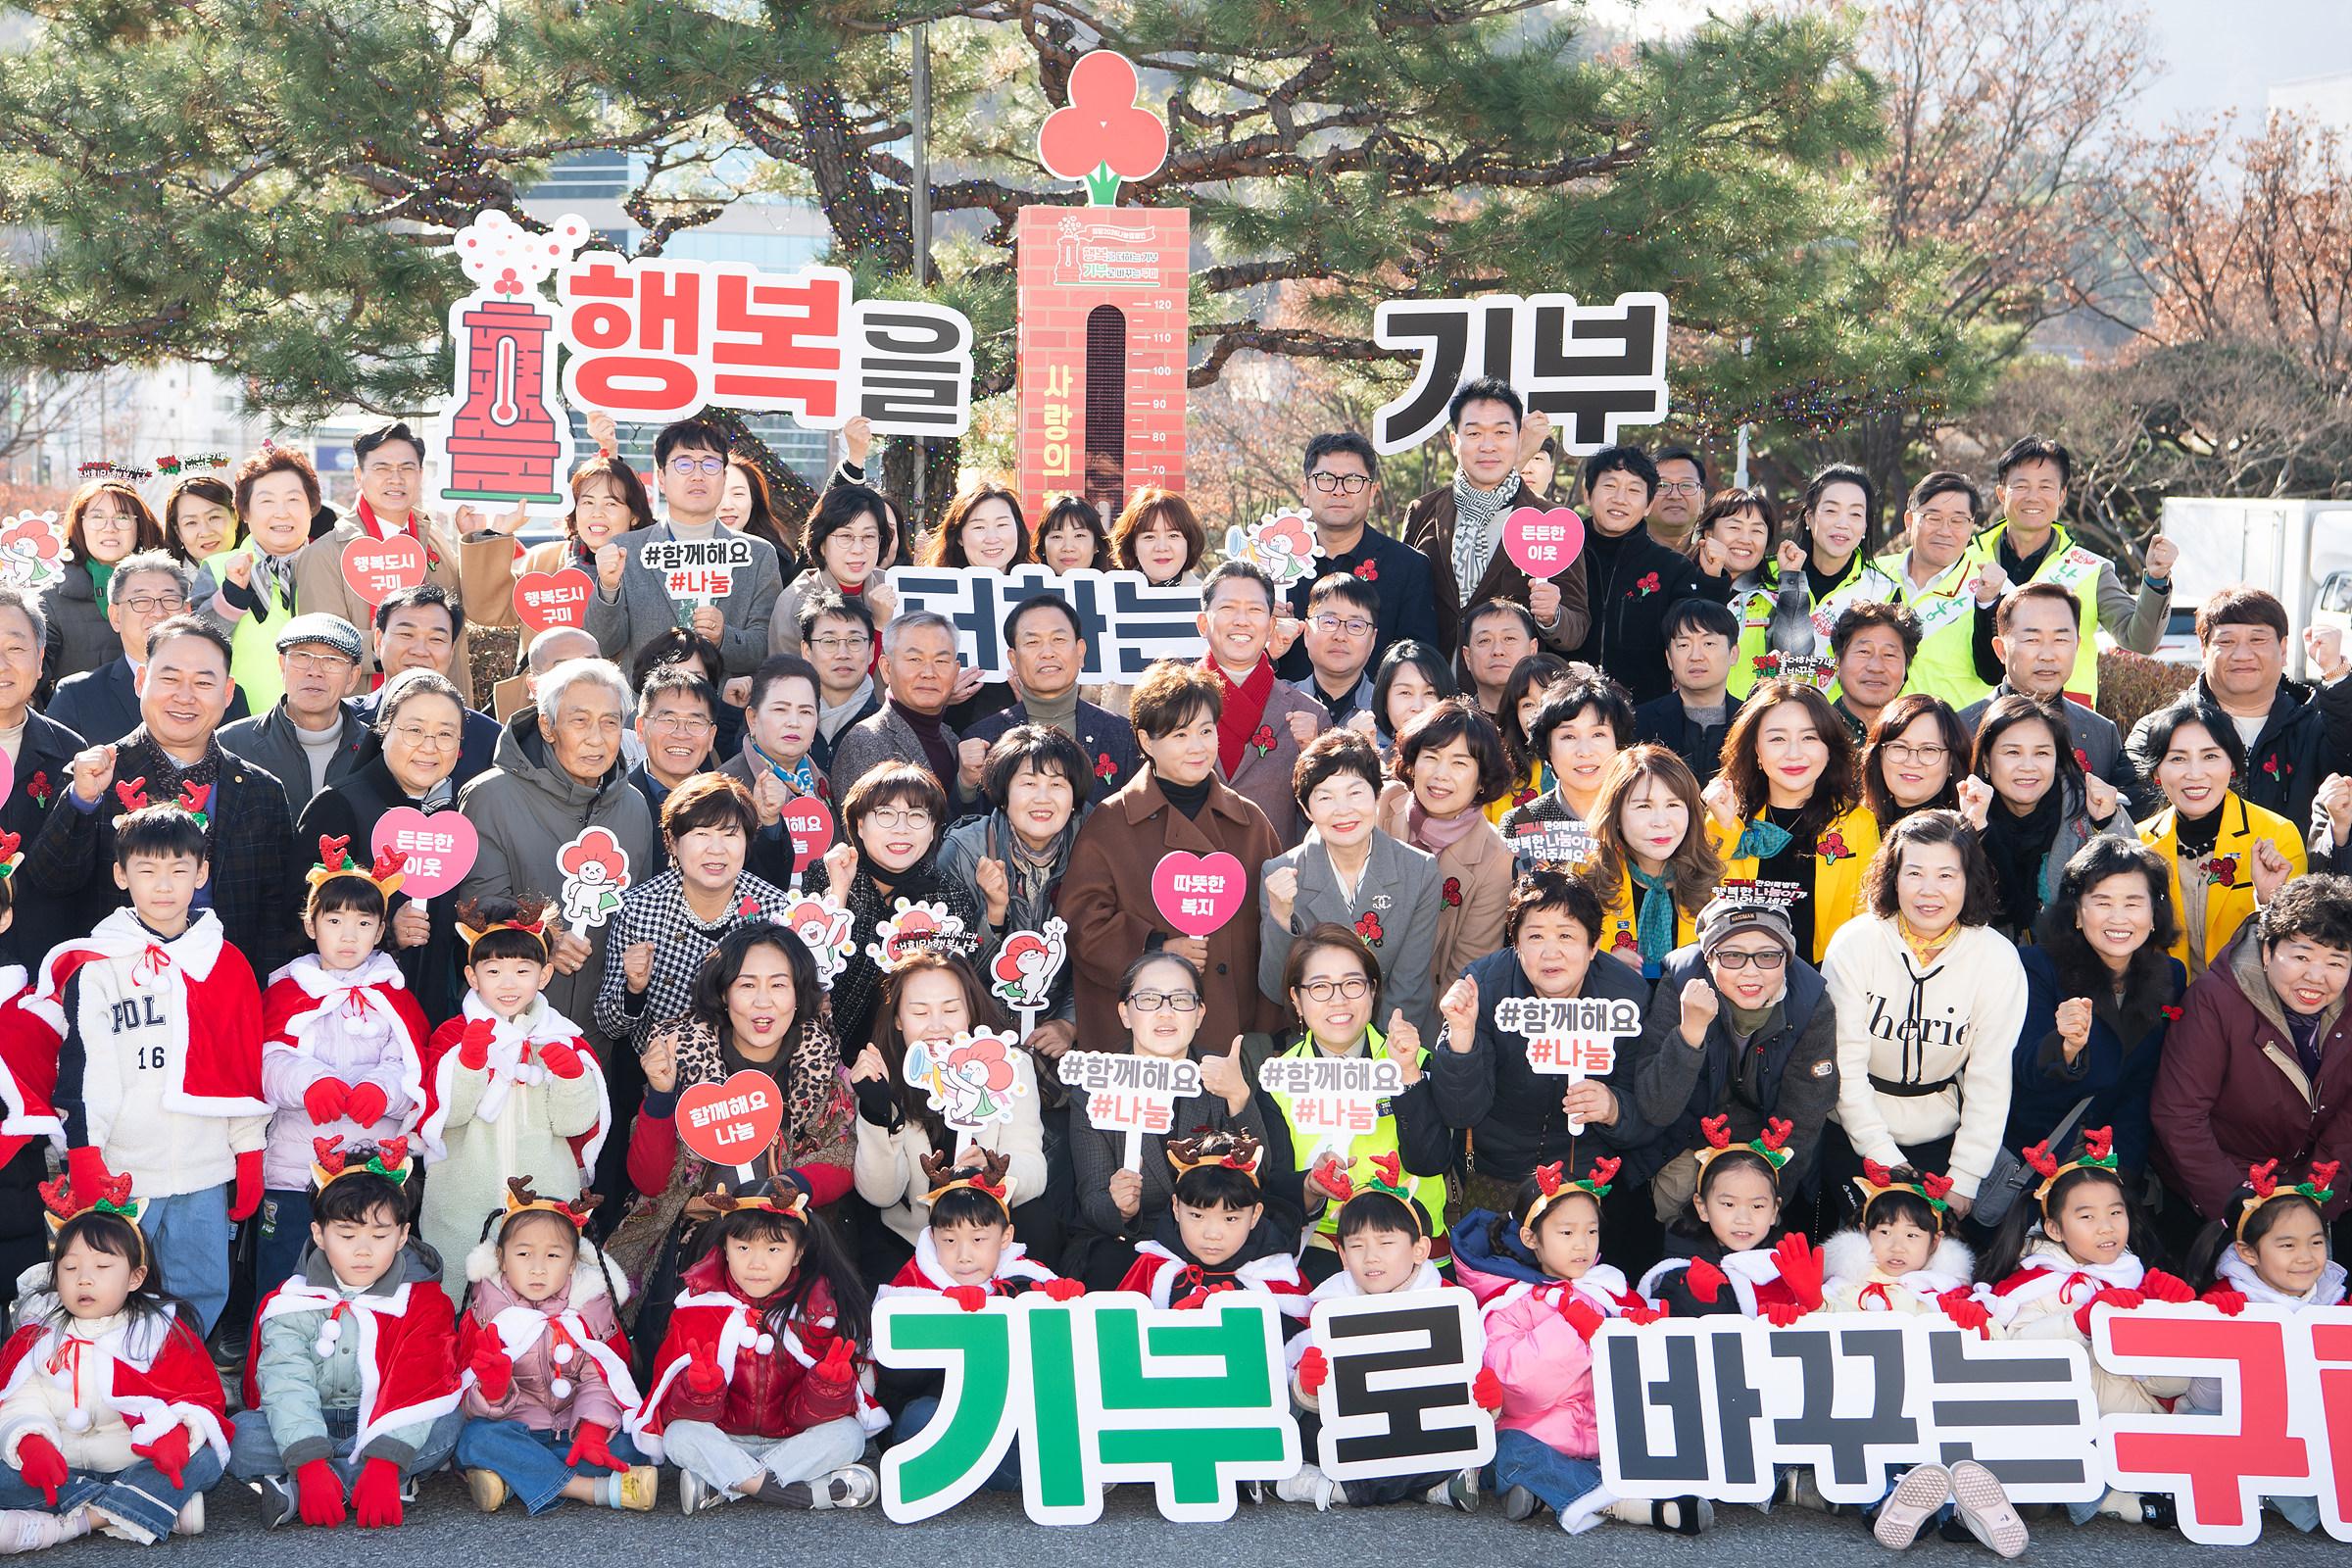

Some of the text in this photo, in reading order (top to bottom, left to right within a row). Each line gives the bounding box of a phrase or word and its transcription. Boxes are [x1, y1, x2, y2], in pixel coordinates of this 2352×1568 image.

[1153, 300, 1172, 310] 120
[1153, 333, 1172, 342] 110
[1152, 367, 1171, 376] 100
[1386, 305, 1656, 444] 기부
[1152, 400, 1167, 409] 90
[1042, 365, 1073, 477] 사랑의
[1152, 432, 1166, 442] 80
[1152, 466, 1165, 475] 70
[1521, 524, 1566, 542] 든든한
[353, 554, 416, 572] 행복도시
[645, 542, 749, 568] #함께해요
[1528, 545, 1558, 563] 이웃
[371, 574, 402, 591] 구미
[670, 570, 729, 594] #나눔
[524, 586, 585, 607] 행복도시
[543, 607, 572, 623] 구미
[784, 815, 822, 831] 해요
[396, 830, 454, 853] 든든한
[1529, 848, 1587, 863] 어주세요.
[403, 856, 442, 878] 이웃
[1174, 875, 1226, 893] 따뜻한
[1181, 899, 1214, 916] 복지
[1499, 1003, 1637, 1033] #함께해요
[1867, 992, 1971, 1046] herié
[138, 1047, 165, 1069] 16
[1532, 1039, 1611, 1070] #나눔
[1062, 1055, 1198, 1093] #함께해요
[1263, 1061, 1399, 1093] #함께해요
[689, 1091, 768, 1128] 함께해요
[1092, 1094, 1170, 1129] #나눔
[1296, 1098, 1374, 1129] #나눔
[714, 1122, 755, 1146] 나눔
[1607, 1329, 2085, 1485] 바꾸는
